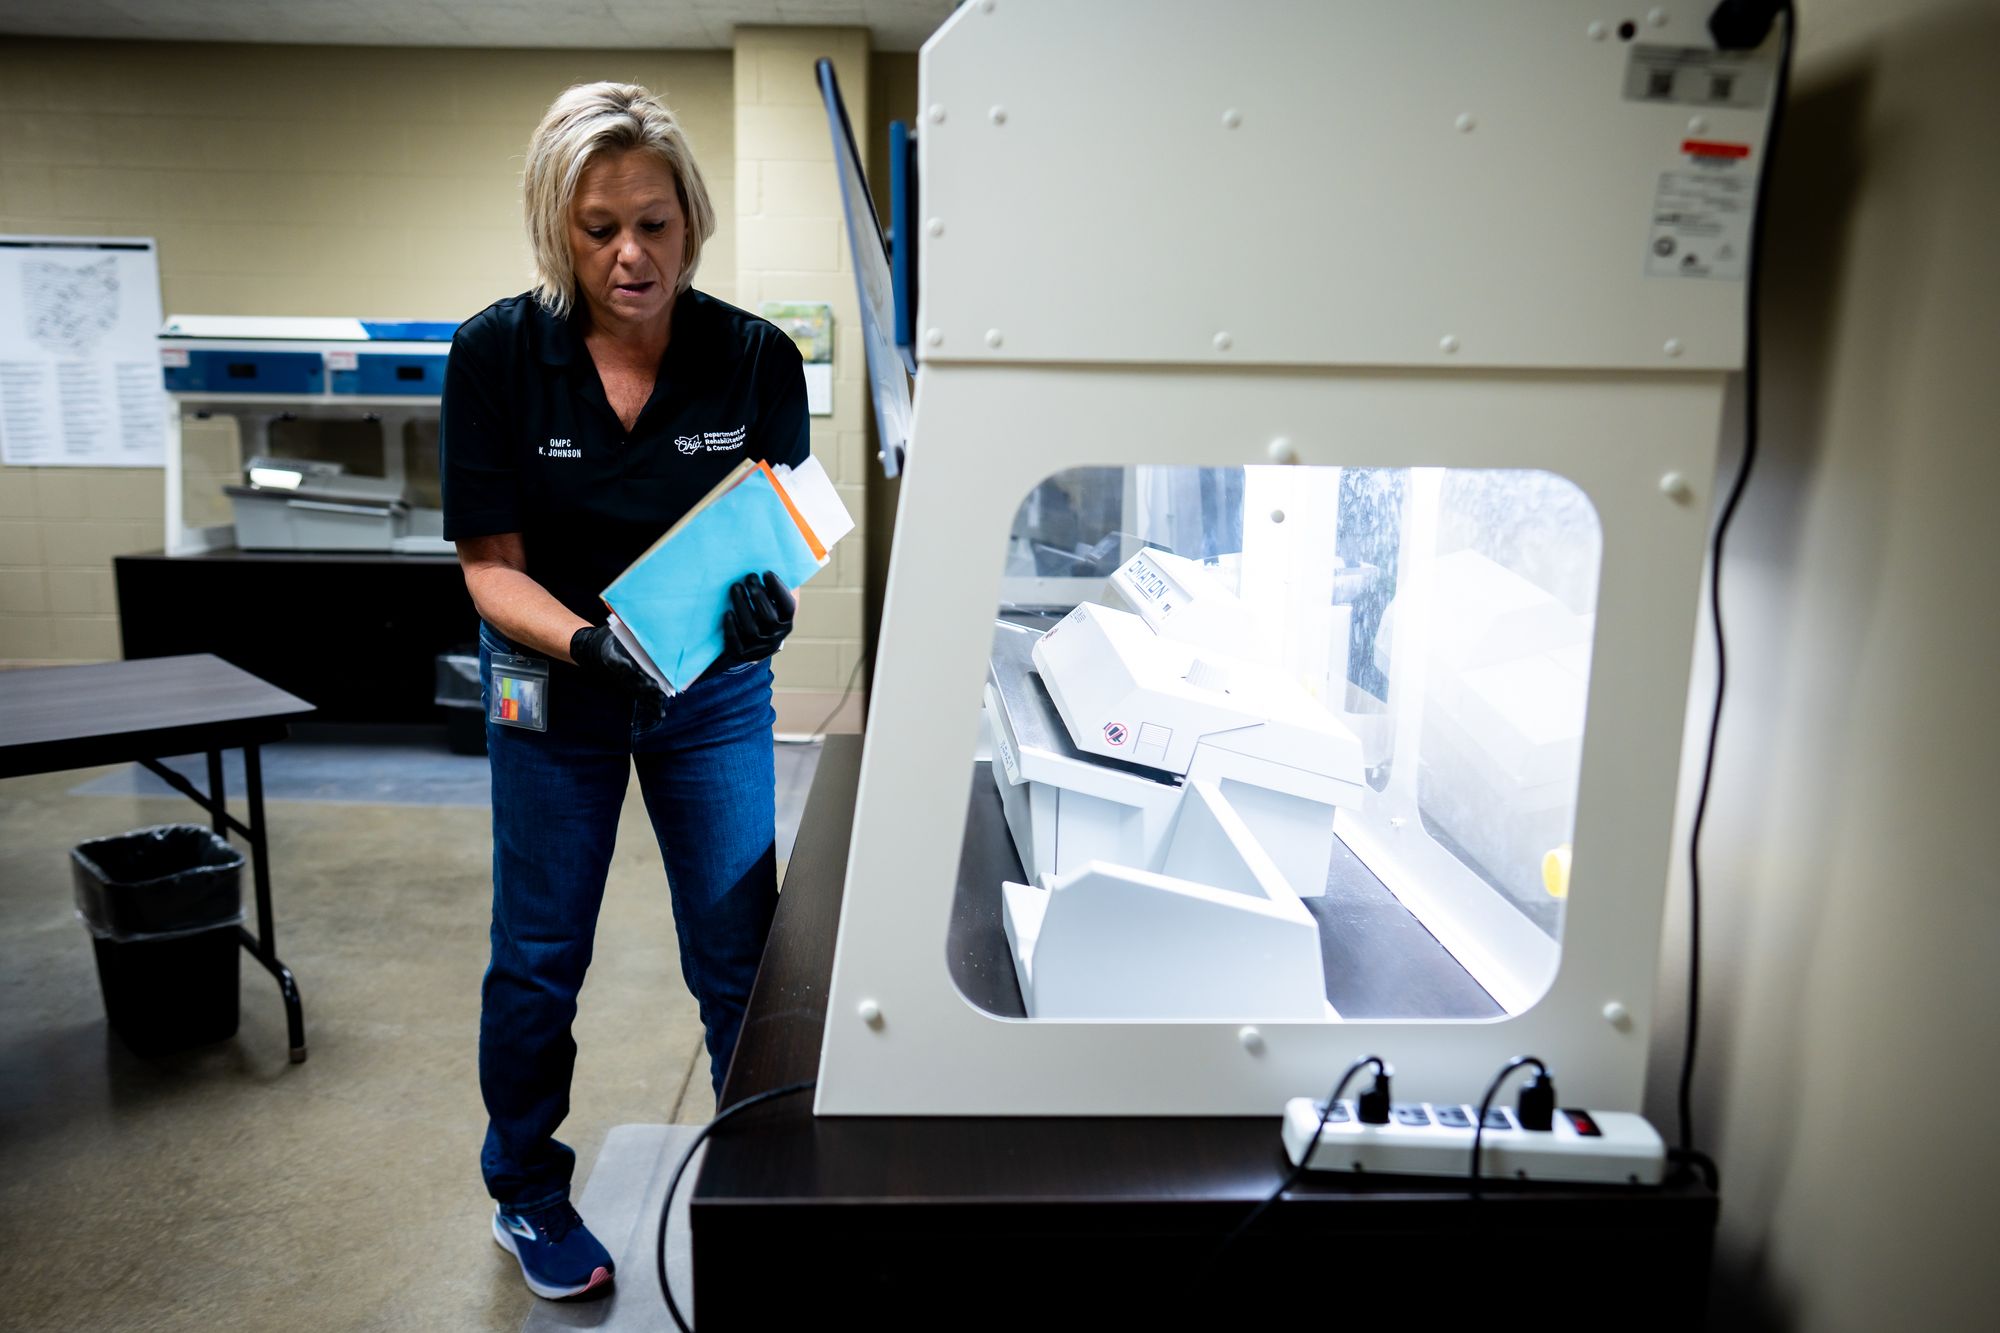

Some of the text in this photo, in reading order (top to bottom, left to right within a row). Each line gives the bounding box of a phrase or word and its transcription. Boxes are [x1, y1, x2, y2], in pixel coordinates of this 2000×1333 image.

[704, 424, 746, 440] Department of
[550, 438, 572, 448] OMPC
[705, 433, 746, 444] Rehabilitation
[674, 439, 702, 452] Ohio
[712, 441, 743, 450] Correction
[538, 446, 582, 458] K. JOHNSON
[1128, 560, 1169, 599] OMATION
